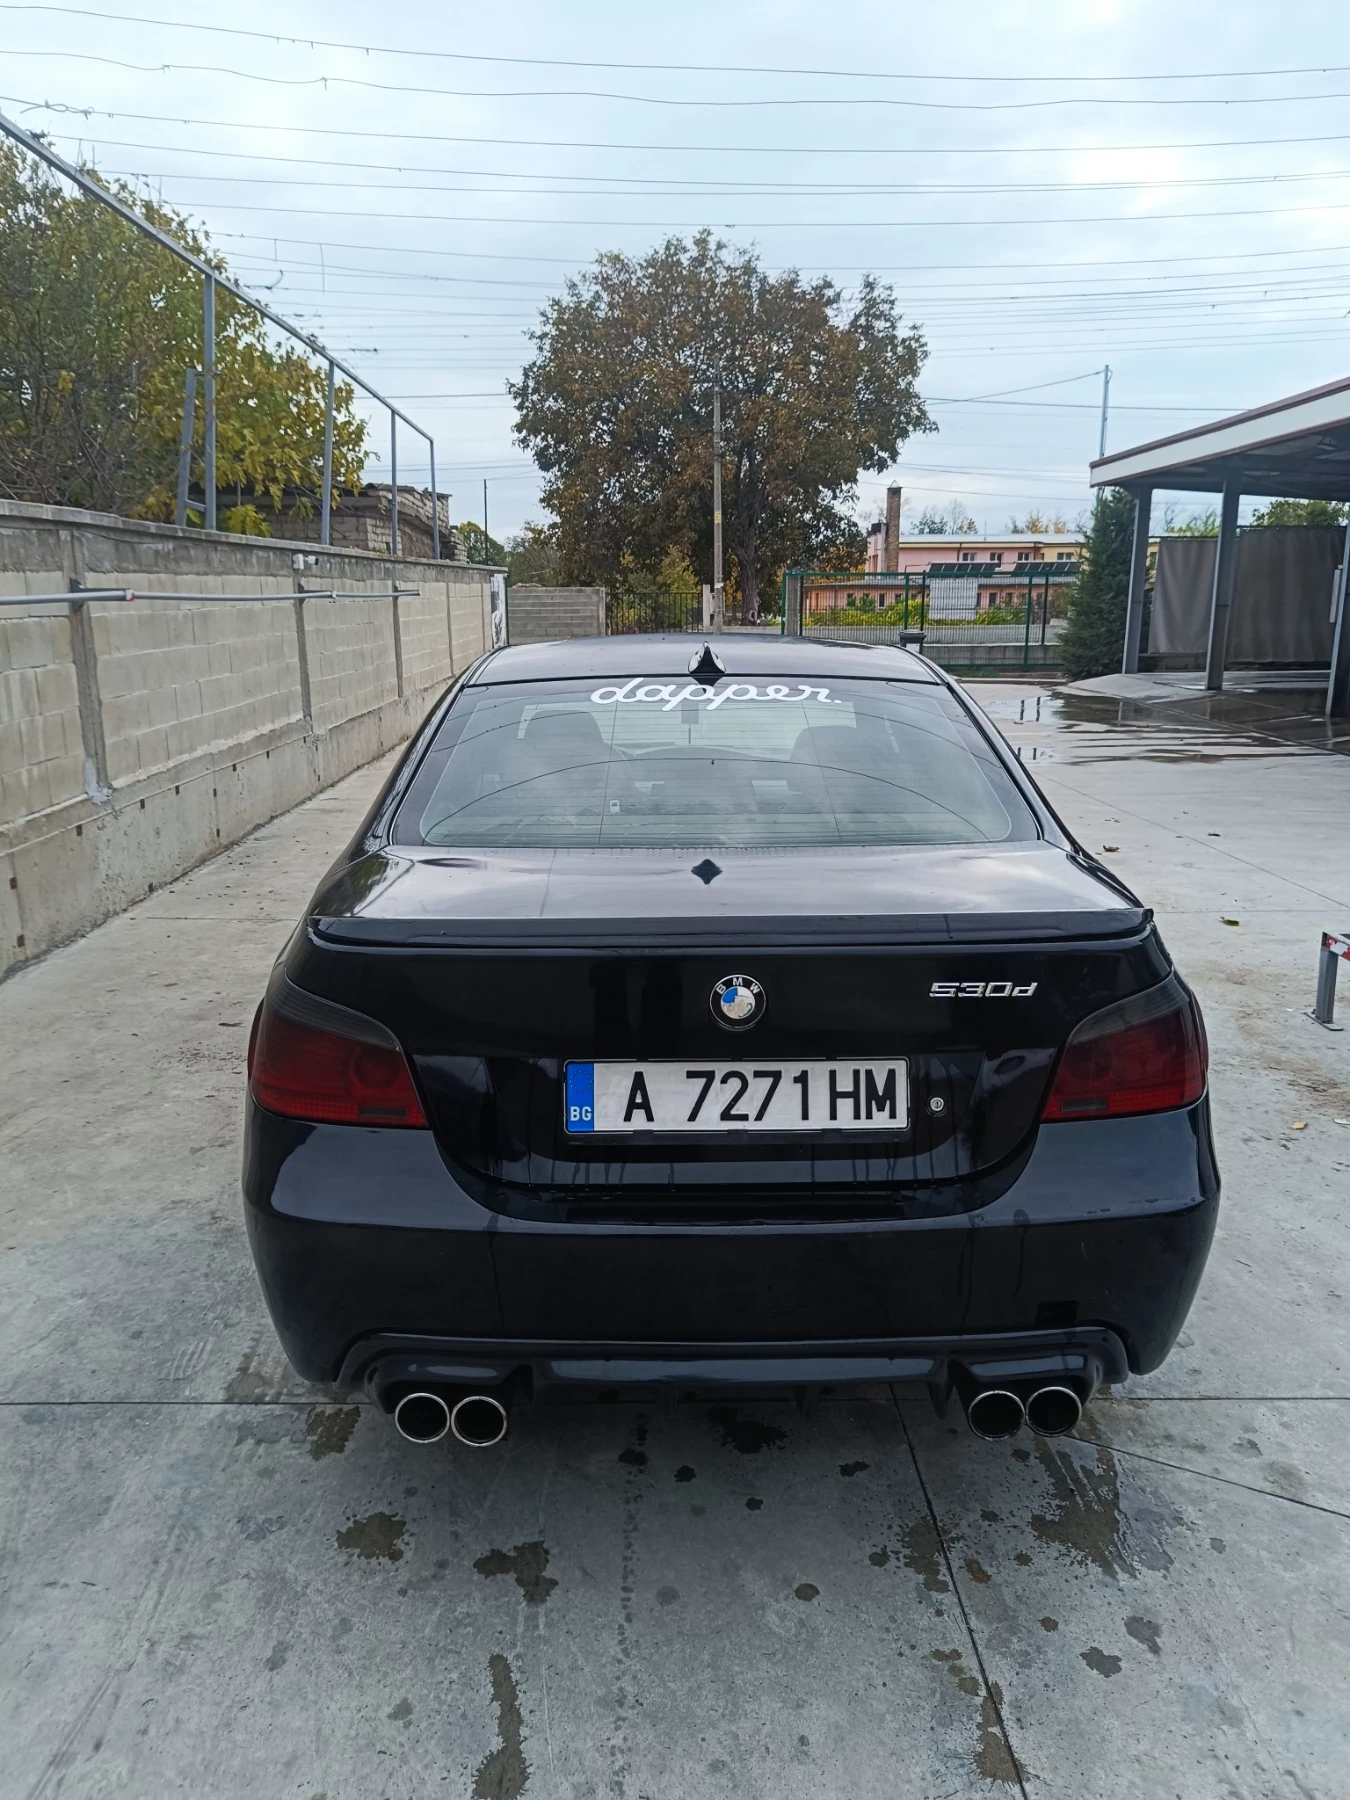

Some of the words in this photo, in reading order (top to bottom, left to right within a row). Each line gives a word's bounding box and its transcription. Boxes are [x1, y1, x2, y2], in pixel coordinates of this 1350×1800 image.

[716, 977, 760, 995] BMW
[929, 982, 1038, 997] 530d
[623, 1071, 655, 1123] A
[686, 1069, 808, 1122] 7271
[828, 1068, 897, 1121] HM
[569, 1106, 592, 1122] BG
